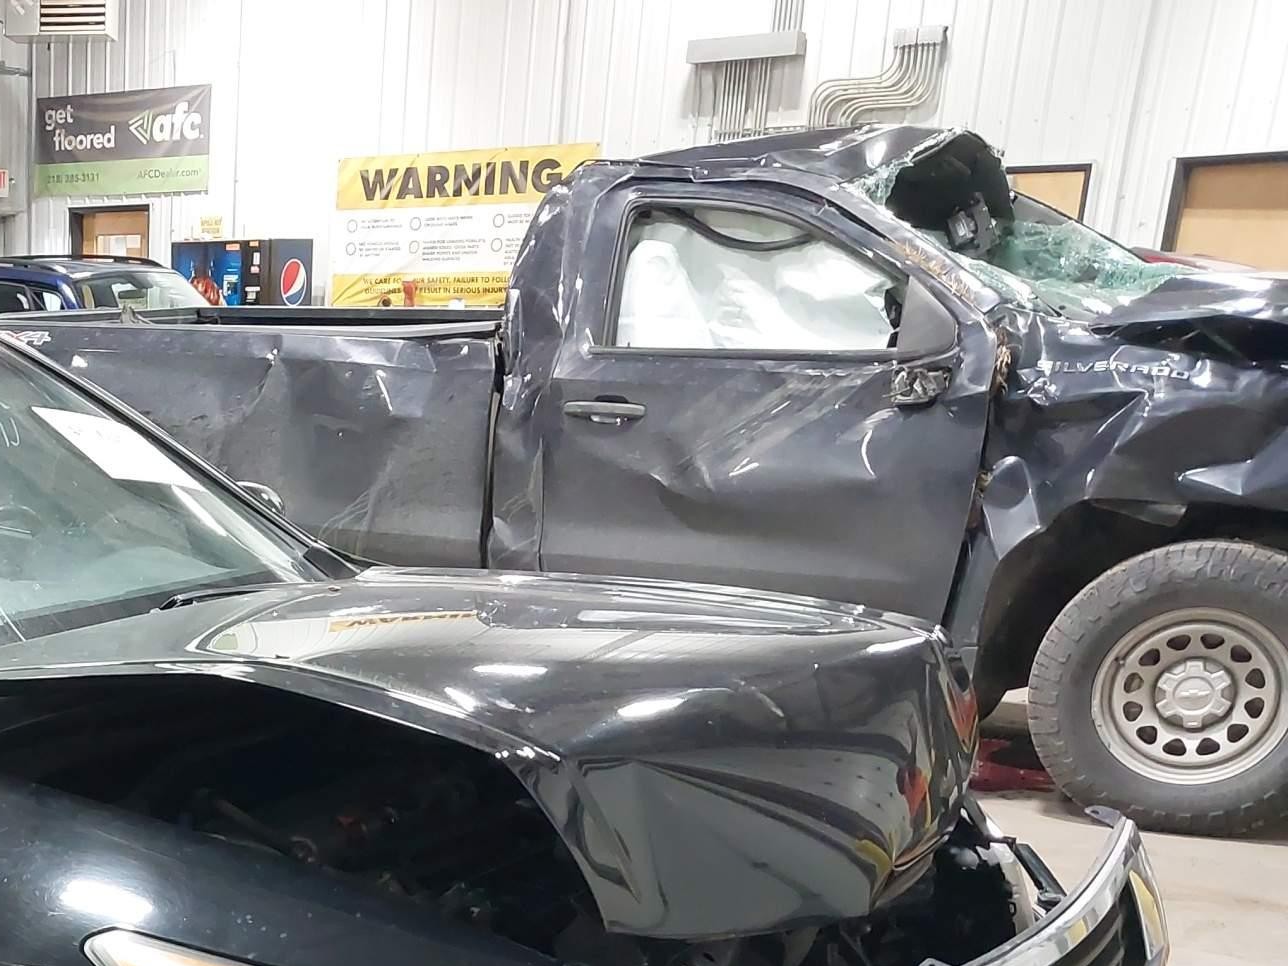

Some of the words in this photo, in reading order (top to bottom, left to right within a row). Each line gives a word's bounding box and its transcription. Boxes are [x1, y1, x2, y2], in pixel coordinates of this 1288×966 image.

[45, 105, 73, 130] get
[54, 125, 115, 150] floored
[360, 158, 562, 200] WARNING
